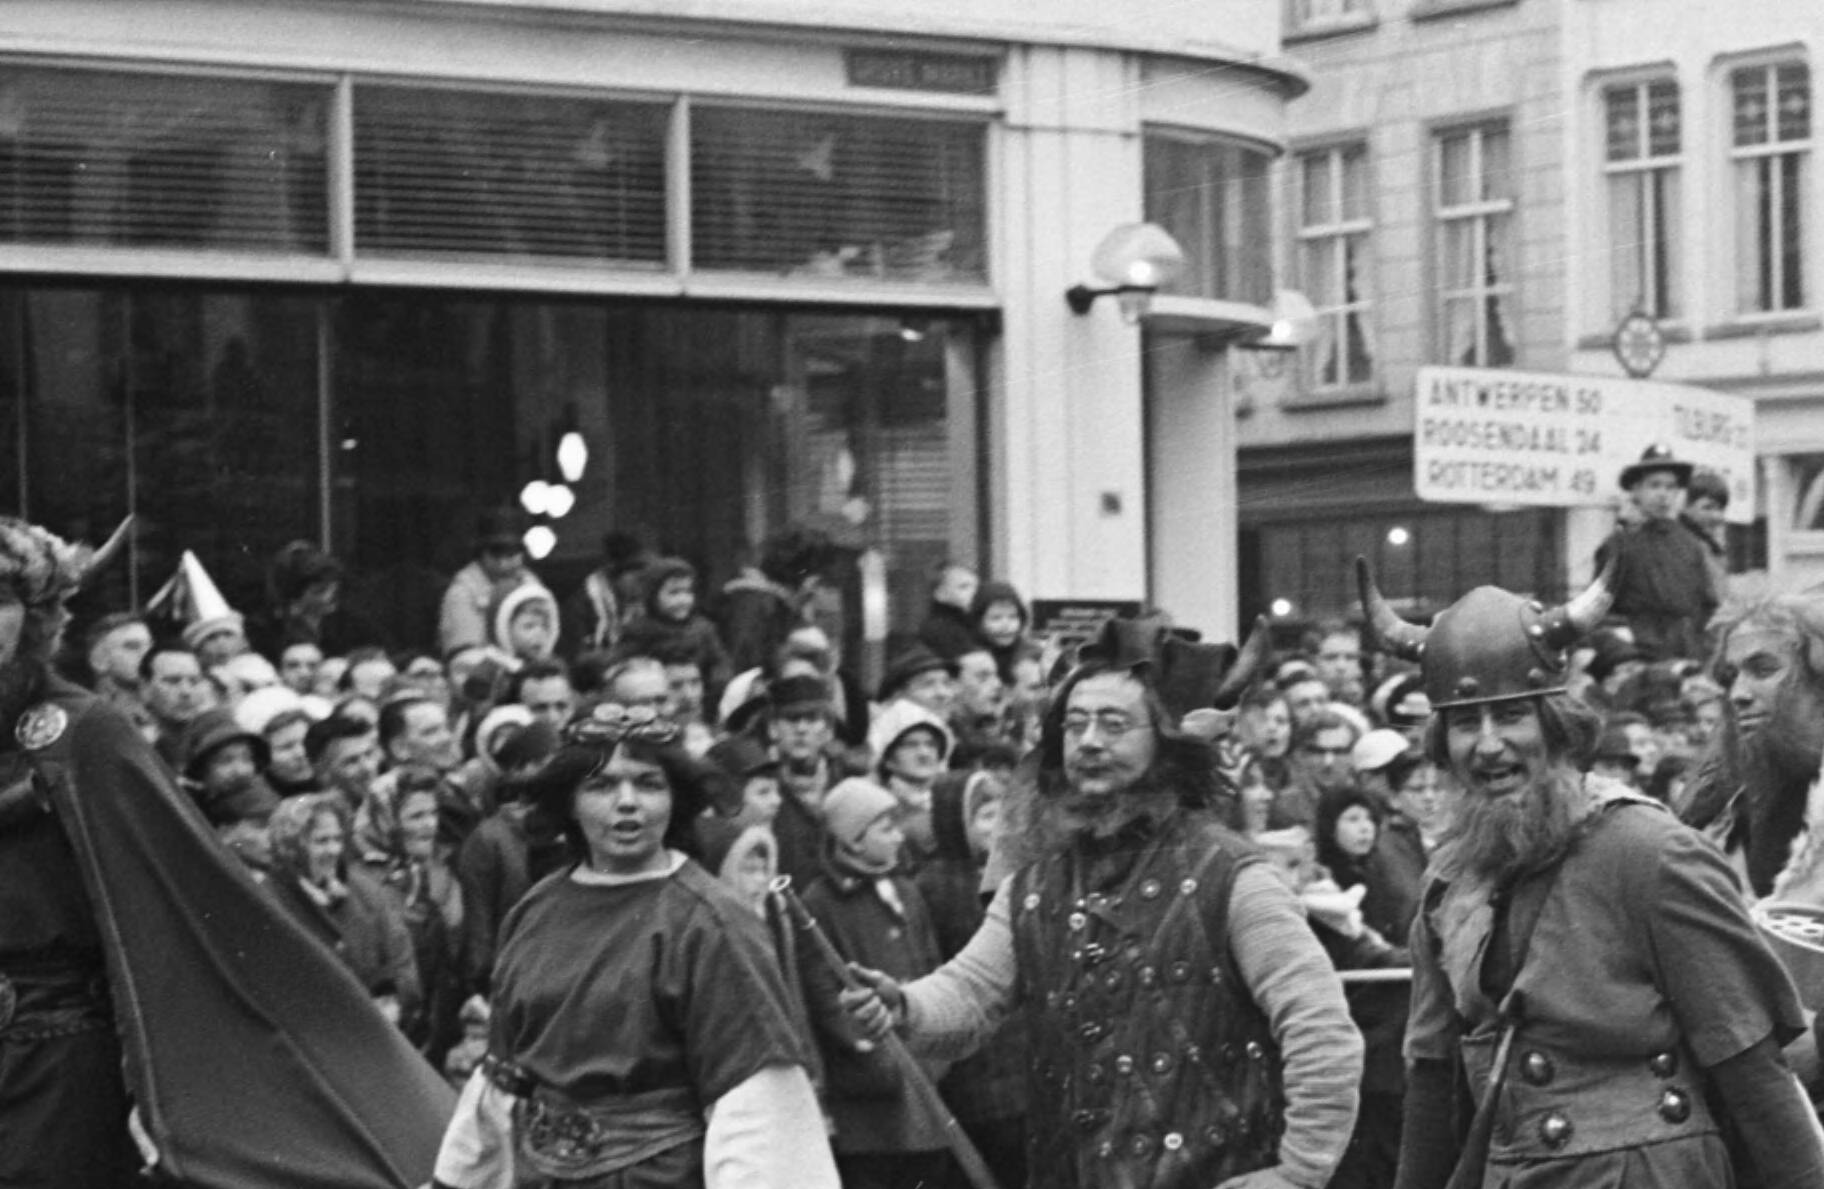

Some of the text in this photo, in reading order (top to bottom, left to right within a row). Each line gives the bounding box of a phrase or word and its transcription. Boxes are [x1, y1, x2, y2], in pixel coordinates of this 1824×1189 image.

[1429, 379, 1602, 414] ANTWERPEN 50
[1422, 418, 1601, 455] ROOSENDAAL 24
[1427, 459, 1559, 491] ROTTERDAM
